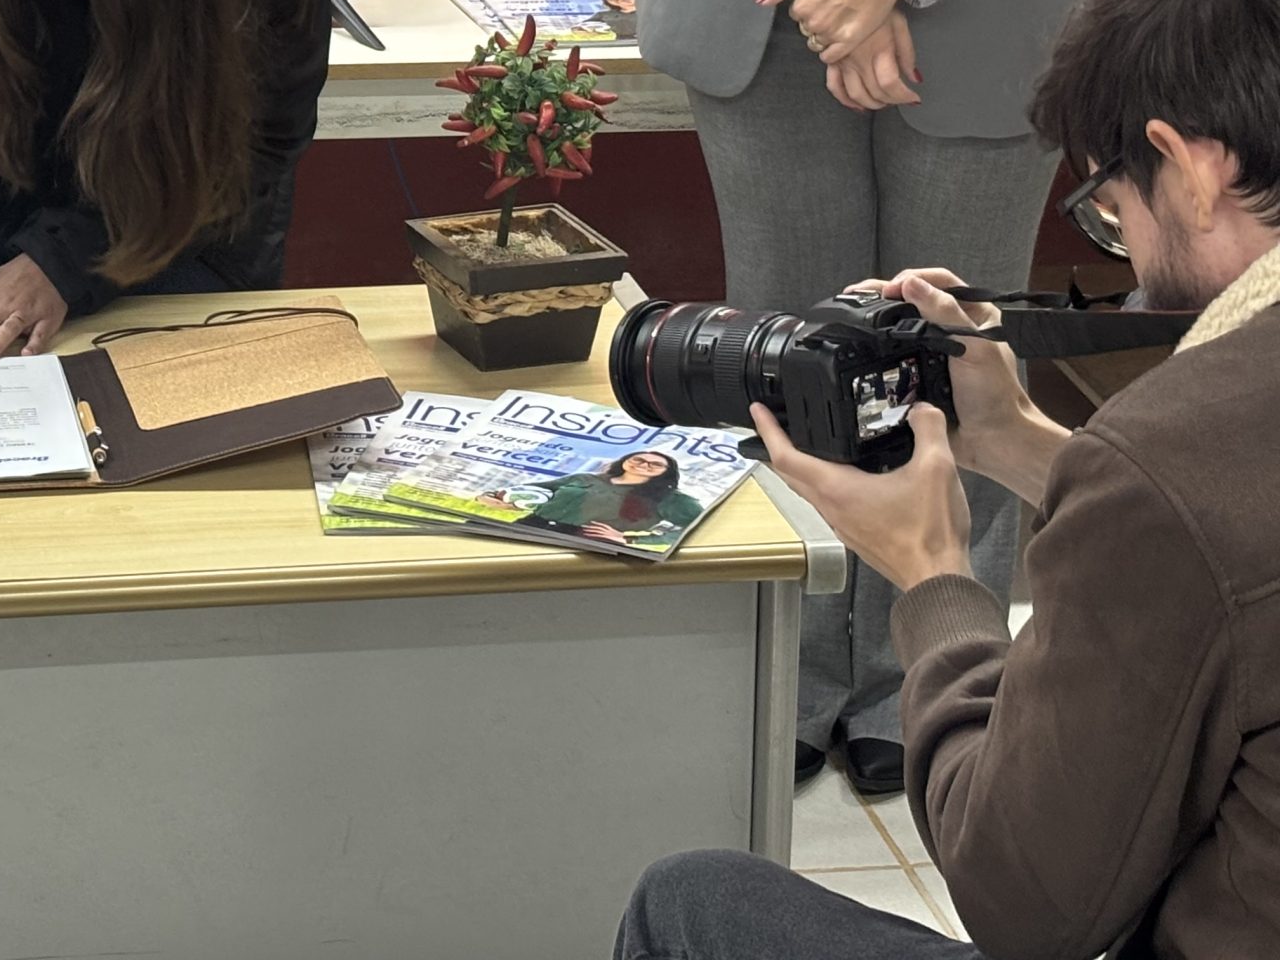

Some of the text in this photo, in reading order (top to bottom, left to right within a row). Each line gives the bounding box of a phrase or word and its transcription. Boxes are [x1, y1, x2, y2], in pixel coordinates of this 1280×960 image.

[477, 430, 574, 452] Jogando
[497, 395, 738, 463] Insights
[461, 441, 559, 465] vencer
